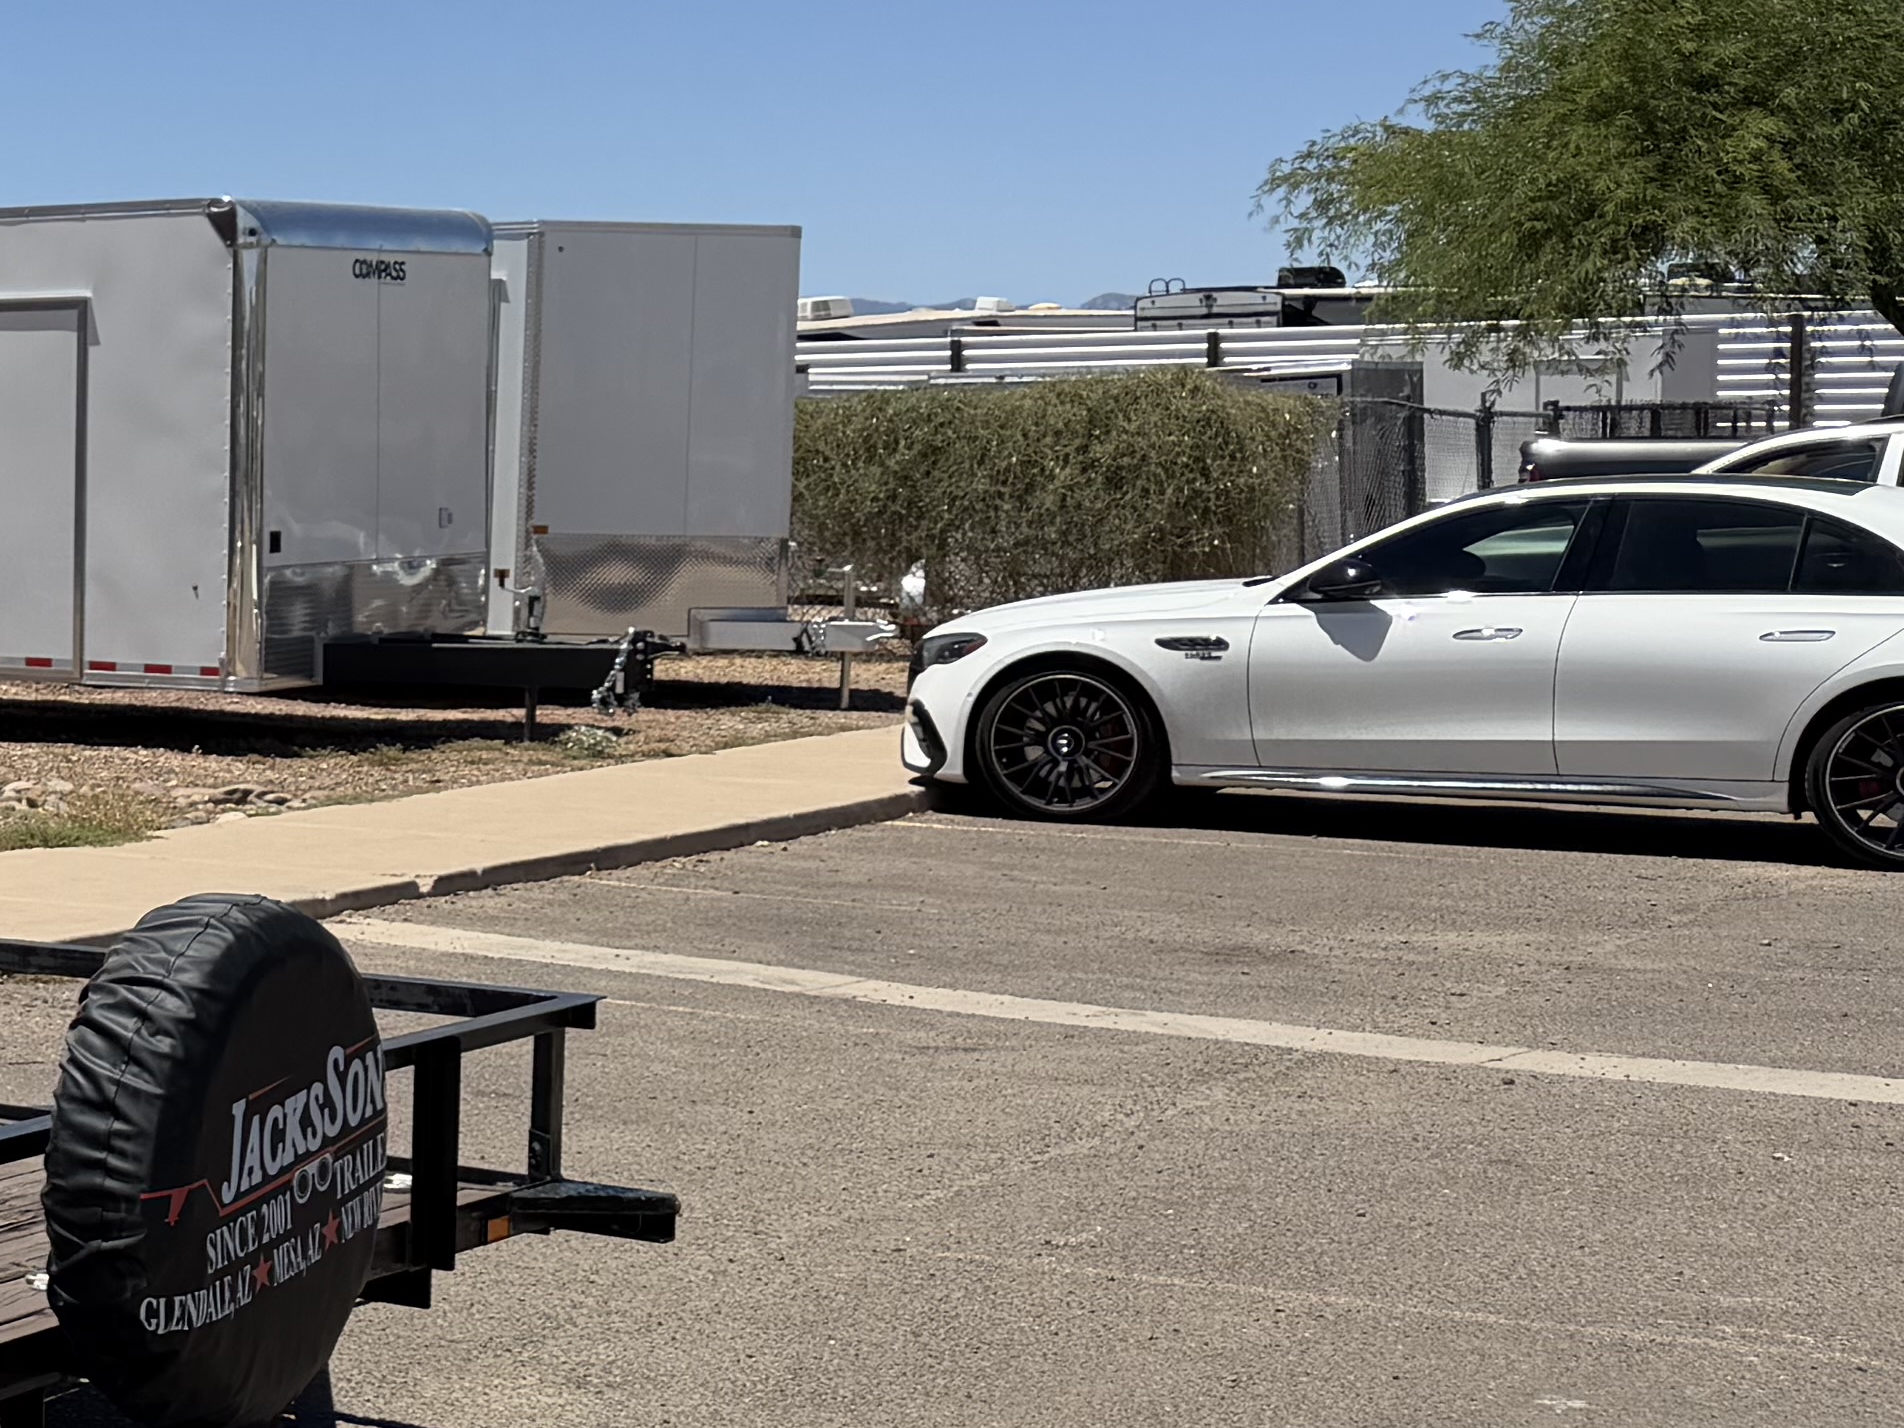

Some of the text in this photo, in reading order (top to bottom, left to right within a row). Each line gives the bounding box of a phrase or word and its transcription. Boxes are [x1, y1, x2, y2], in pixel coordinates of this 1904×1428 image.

[352, 258, 406, 281] COMPASS
[206, 1212, 259, 1274] SINCE
[261, 1190, 292, 1244] 2001
